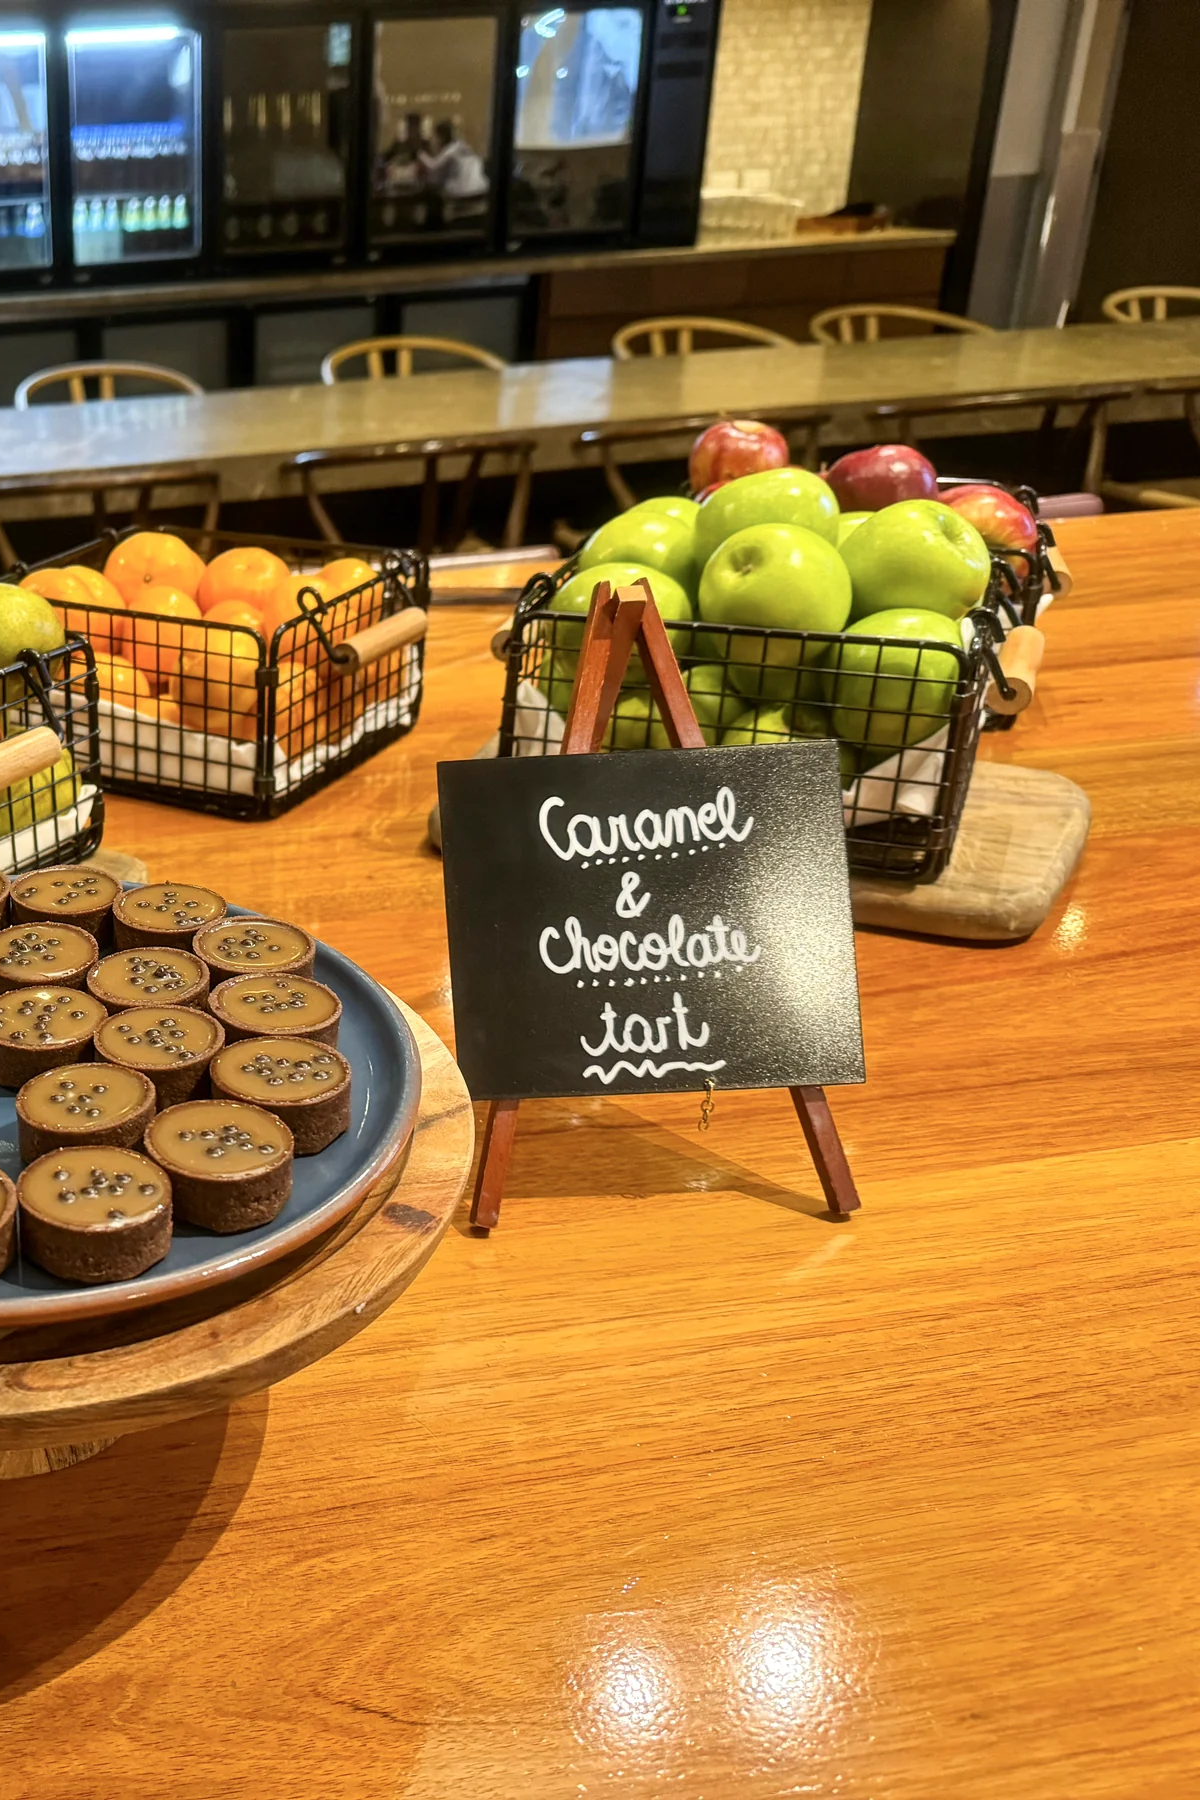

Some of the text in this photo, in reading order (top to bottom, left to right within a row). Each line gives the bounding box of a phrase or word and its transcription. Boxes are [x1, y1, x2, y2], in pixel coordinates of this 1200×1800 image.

[538, 786, 755, 862] Caramel
[615, 871, 652, 919] &
[580, 992, 710, 1057] tart
